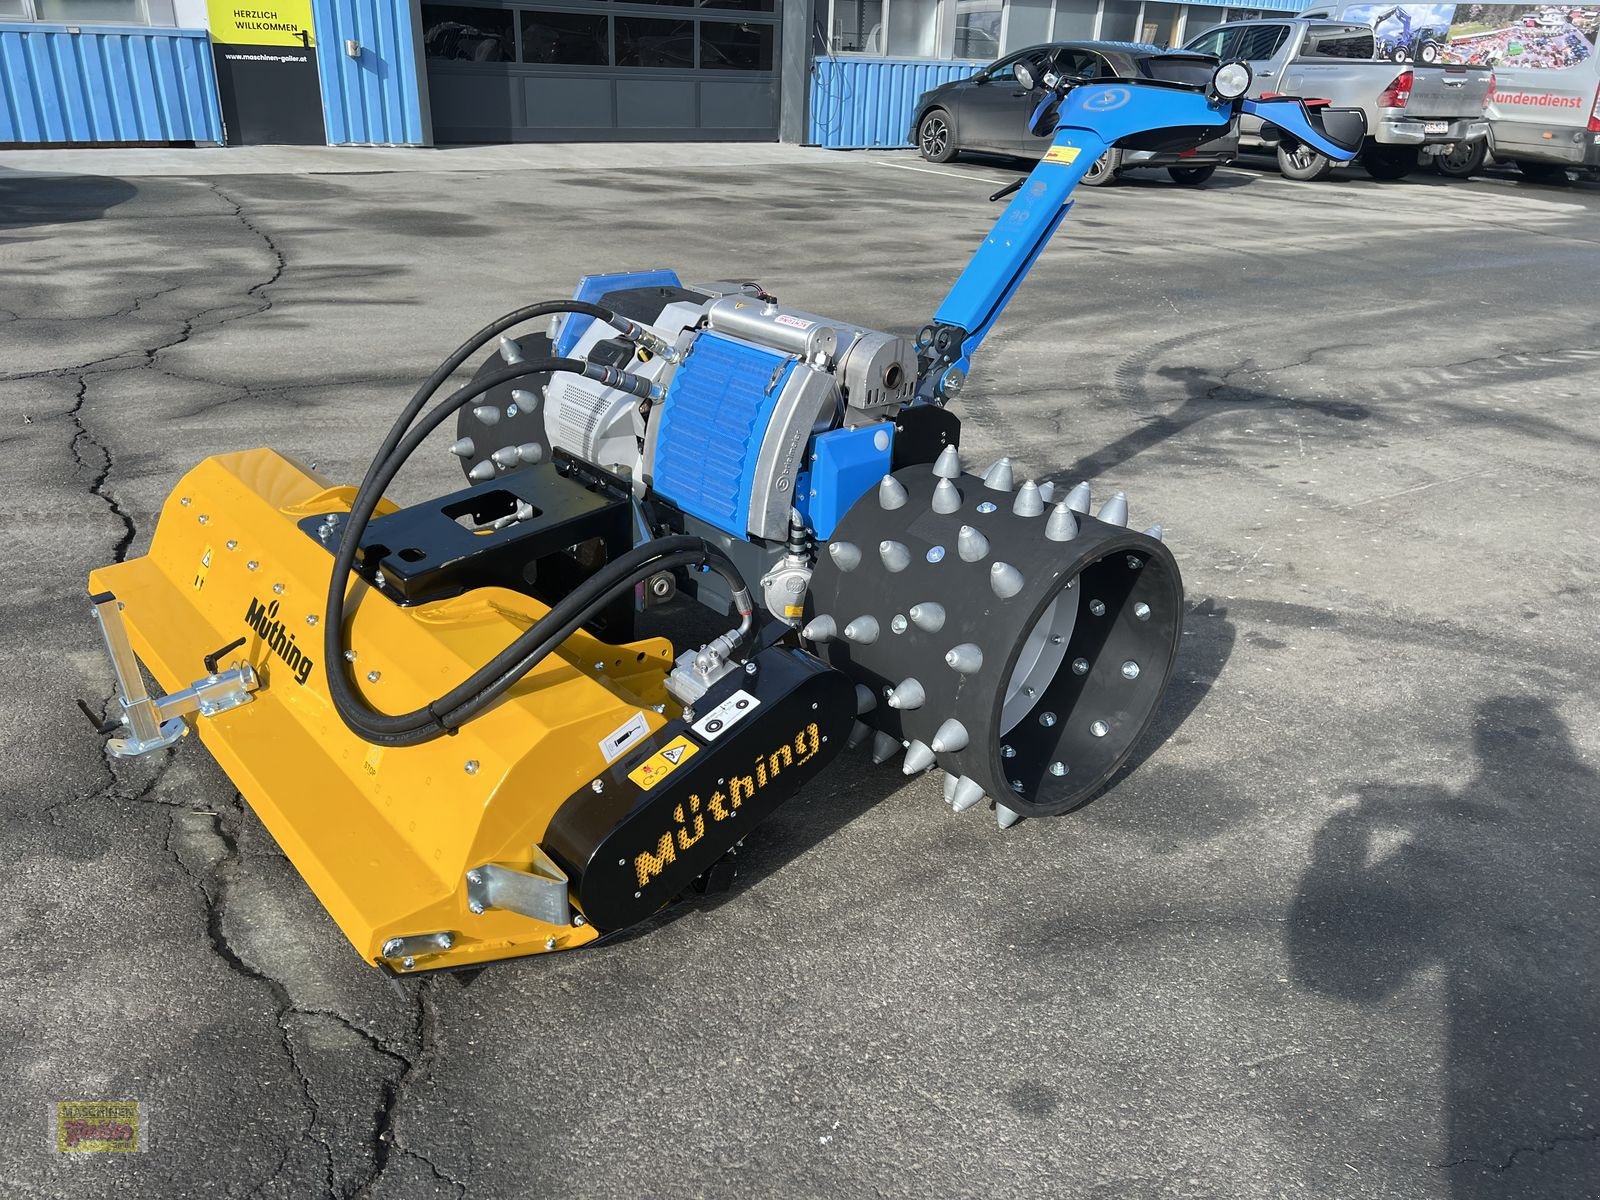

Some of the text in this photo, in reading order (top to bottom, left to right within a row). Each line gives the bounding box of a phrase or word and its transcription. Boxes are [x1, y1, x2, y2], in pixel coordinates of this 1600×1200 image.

[233, 9, 278, 20] HERZLICH
[235, 21, 298, 32] WILLKOMMEN
[244, 596, 314, 686] Müthing
[363, 760, 377, 776] STOP
[634, 722, 819, 888] Müthing
